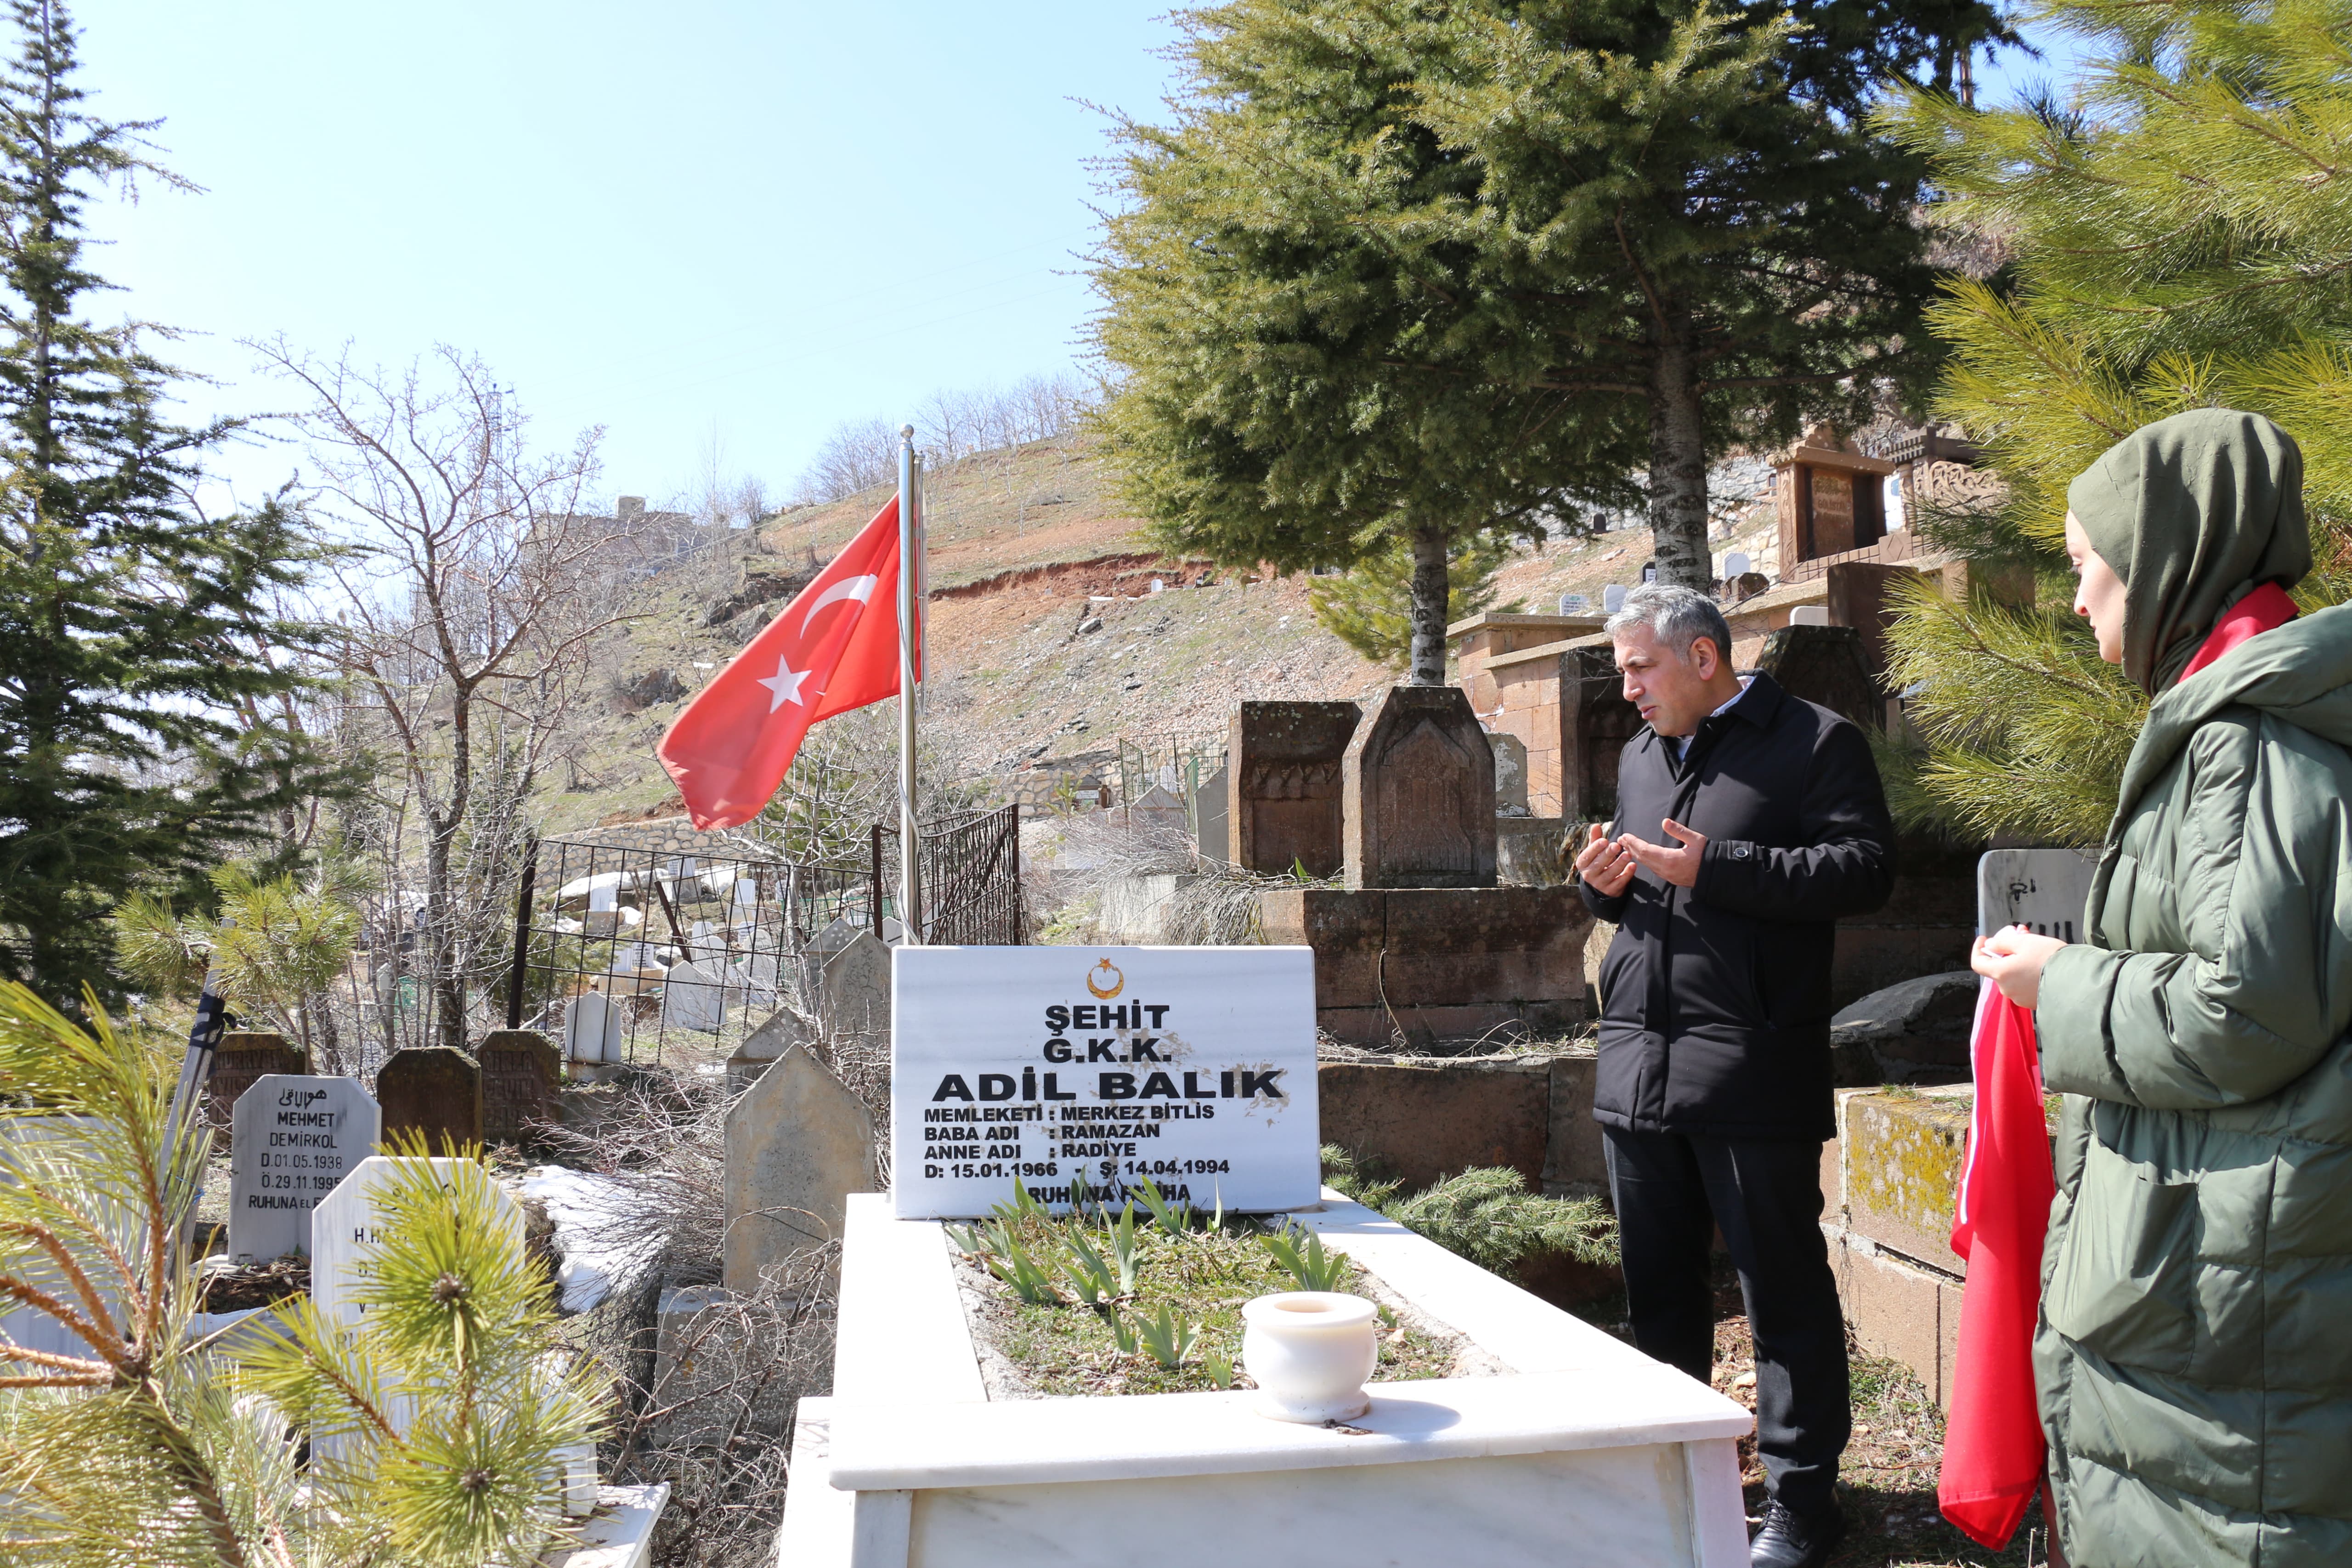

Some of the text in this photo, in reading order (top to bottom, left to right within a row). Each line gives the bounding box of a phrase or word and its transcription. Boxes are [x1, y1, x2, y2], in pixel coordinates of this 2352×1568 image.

[1045, 999, 1170, 1036] ŞEHİT
[1043, 1038, 1172, 1063] G.K.K.
[932, 1066, 1283, 1101] ADİL BALIK
[277, 1111, 334, 1127] MEHMET
[925, 1104, 1042, 1122] MEMLEKETİ
[1061, 1106, 1144, 1121] MERKEZ
[1151, 1102, 1214, 1119] BİTLİS
[270, 1131, 337, 1149] DEMİRKOL
[925, 1127, 979, 1141] BABA
[985, 1126, 1019, 1140] ADI
[1062, 1124, 1160, 1139] RAMAZAN
[924, 1145, 980, 1159] ANNE
[987, 1144, 1021, 1159] ADI
[1062, 1140, 1136, 1158] RADİYE
[261, 1153, 342, 1169] D.01.05.1938
[925, 1165, 944, 1178] D:
[951, 1162, 1057, 1178] 15.01.1966
[1125, 1160, 1230, 1175] 14.04.1994
[249, 1195, 298, 1209] RUHUNA
[300, 1199, 311, 1209] EL
